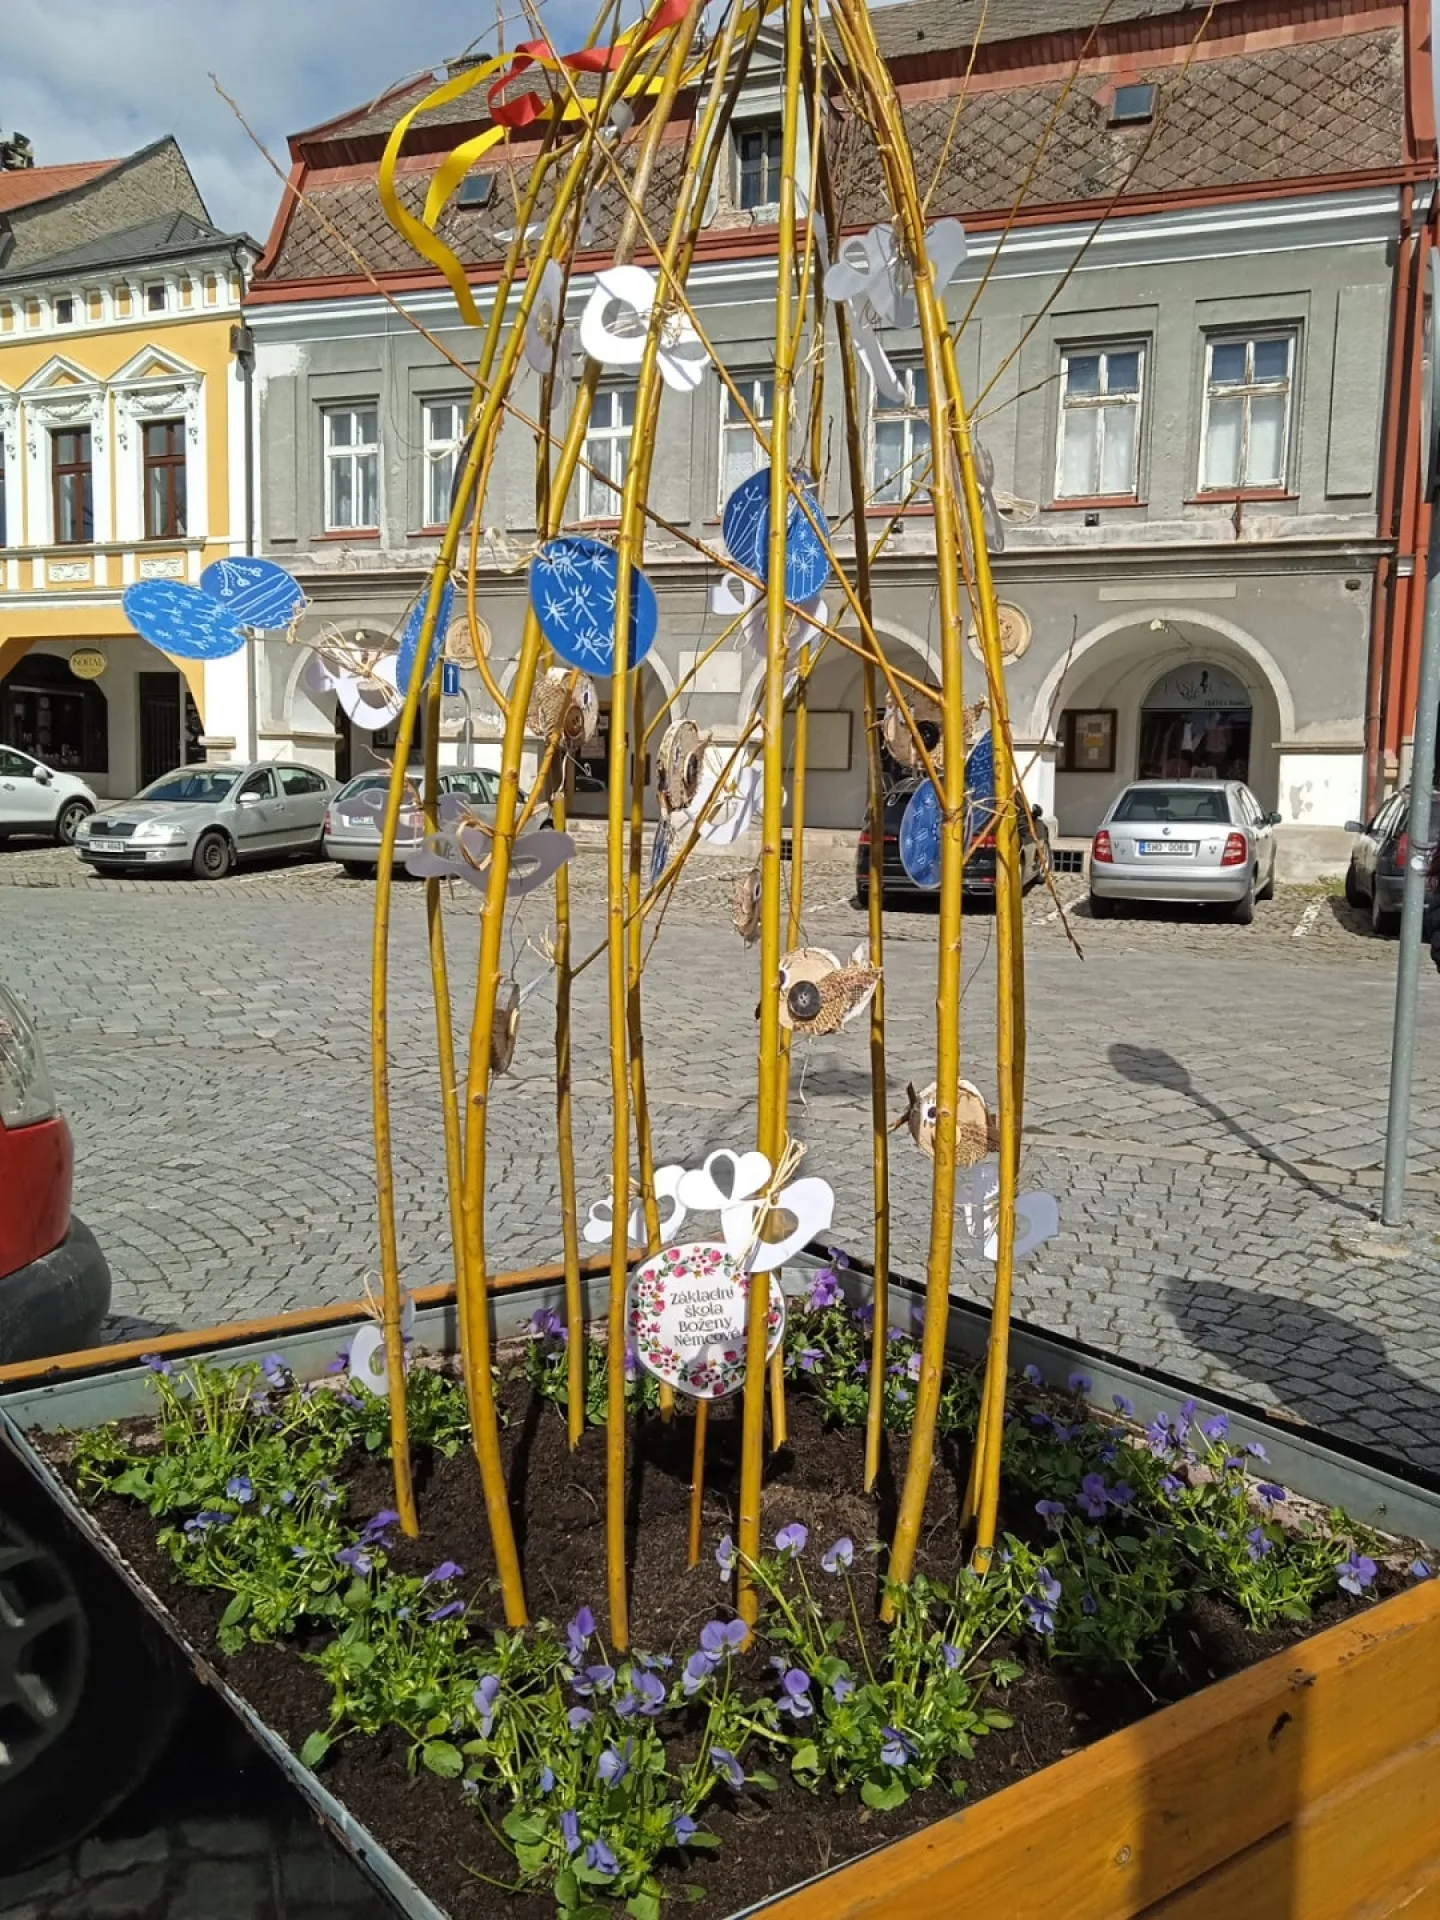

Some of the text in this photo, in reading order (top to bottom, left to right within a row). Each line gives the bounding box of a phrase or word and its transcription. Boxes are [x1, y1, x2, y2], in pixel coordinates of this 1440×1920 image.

[670, 1287, 735, 1305] Základní
[685, 1303, 724, 1318] škola
[678, 1317, 732, 1333] Boženy
[674, 1328, 741, 1347] Němcové
